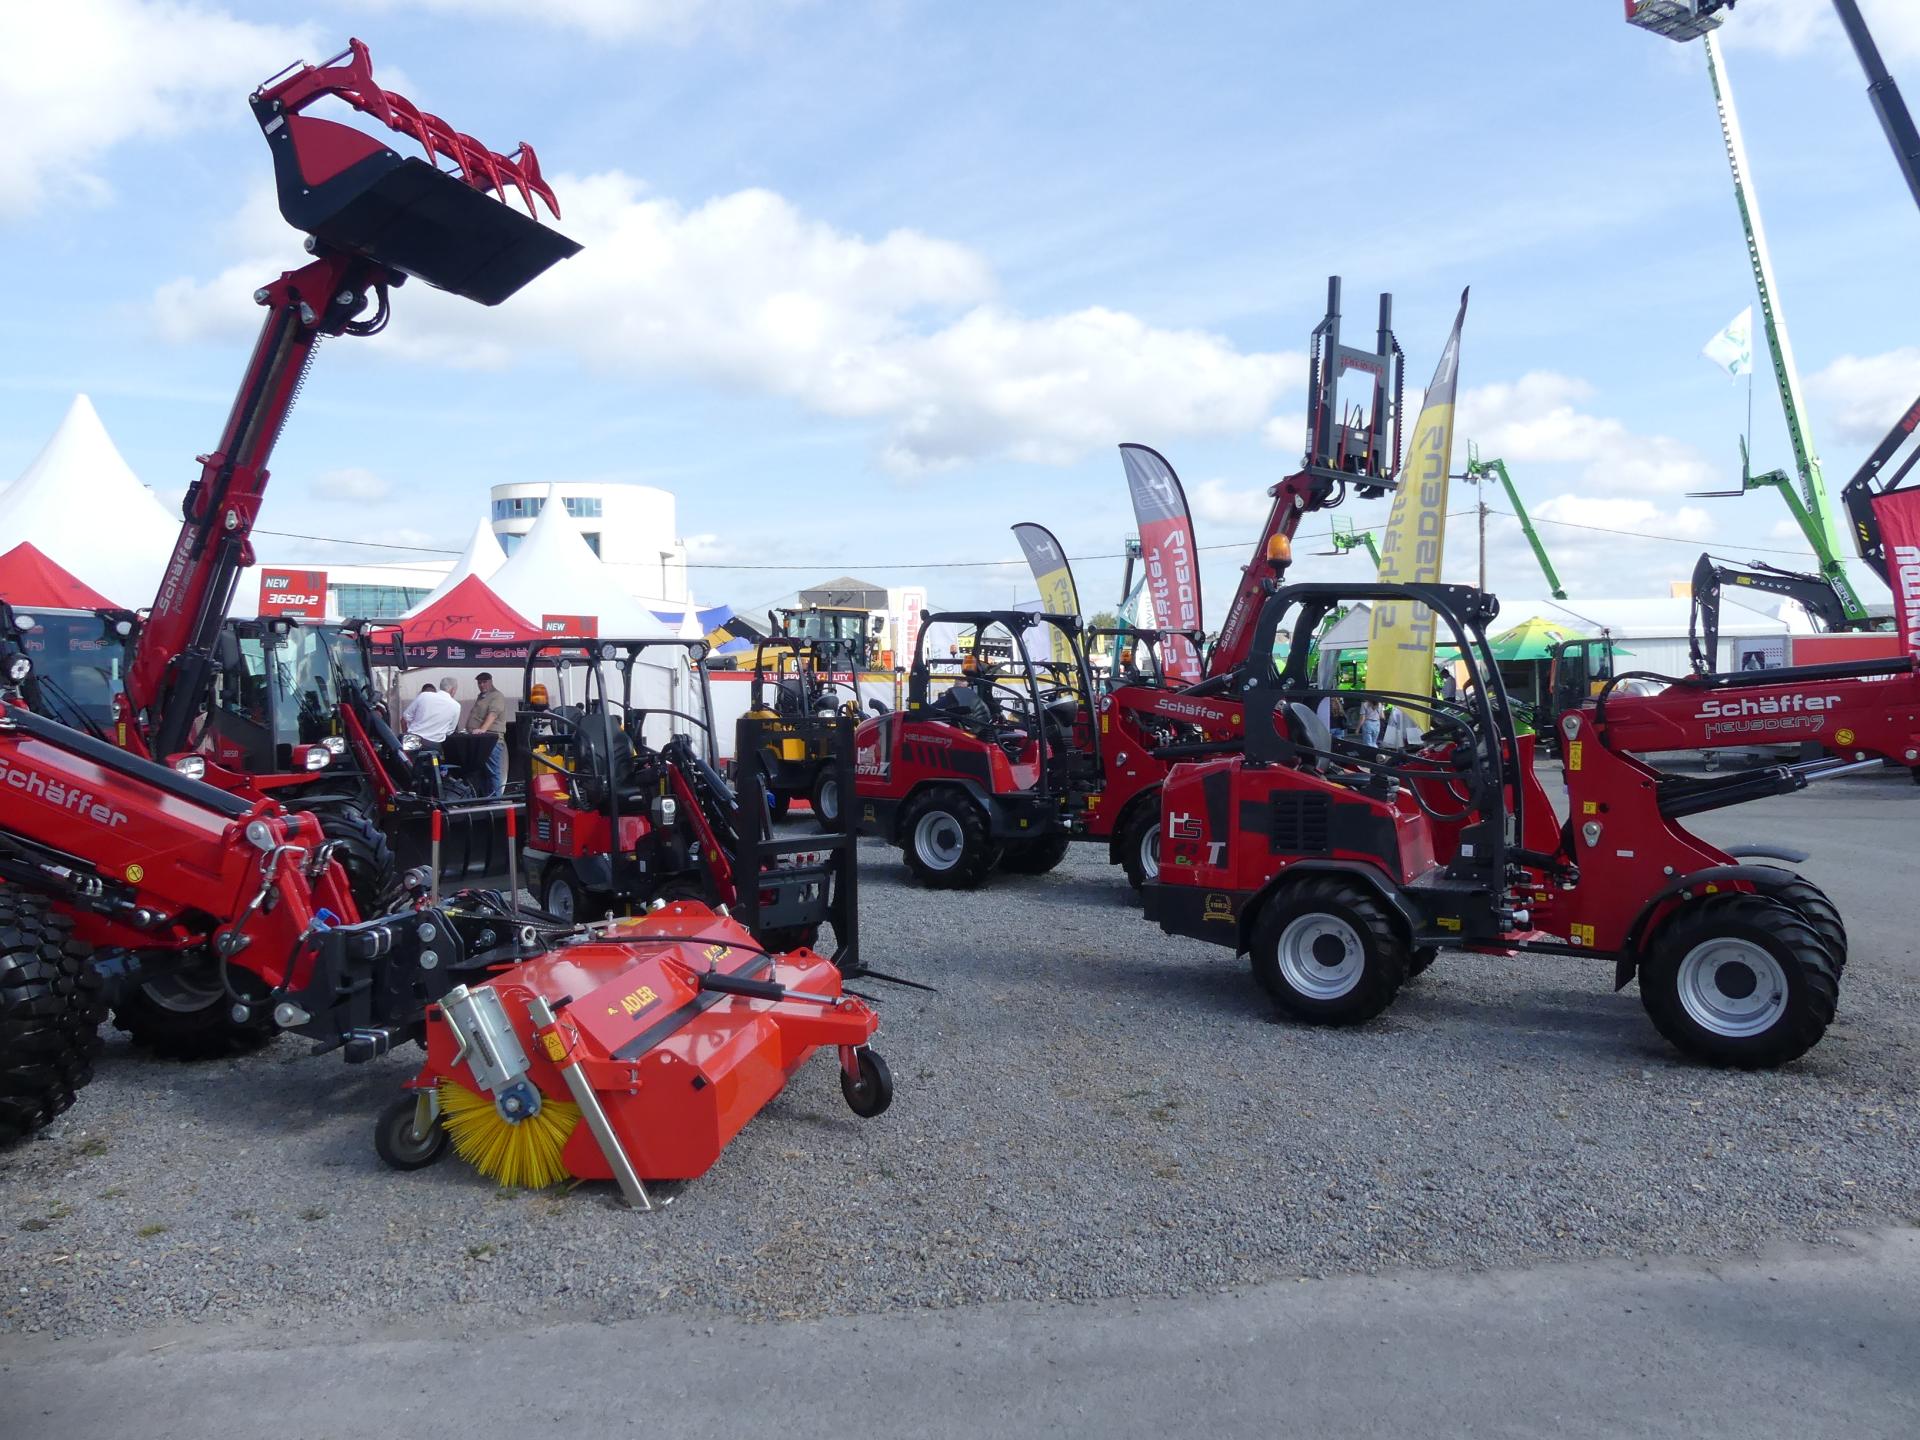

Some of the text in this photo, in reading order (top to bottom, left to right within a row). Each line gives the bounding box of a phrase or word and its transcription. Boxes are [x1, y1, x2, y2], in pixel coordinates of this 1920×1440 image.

[159, 527, 197, 617] Schäffer
[266, 578, 289, 588] NEW
[1751, 579, 1791, 591] VOLVO
[267, 593, 319, 605] 3650-2
[1831, 576, 1858, 613] MERLO
[546, 622, 566, 631] NEW
[1154, 698, 1225, 721] Schäffer
[1694, 694, 1842, 719] Schäffer
[855, 761, 891, 777] 670Z
[620, 985, 659, 1015] ADLER
